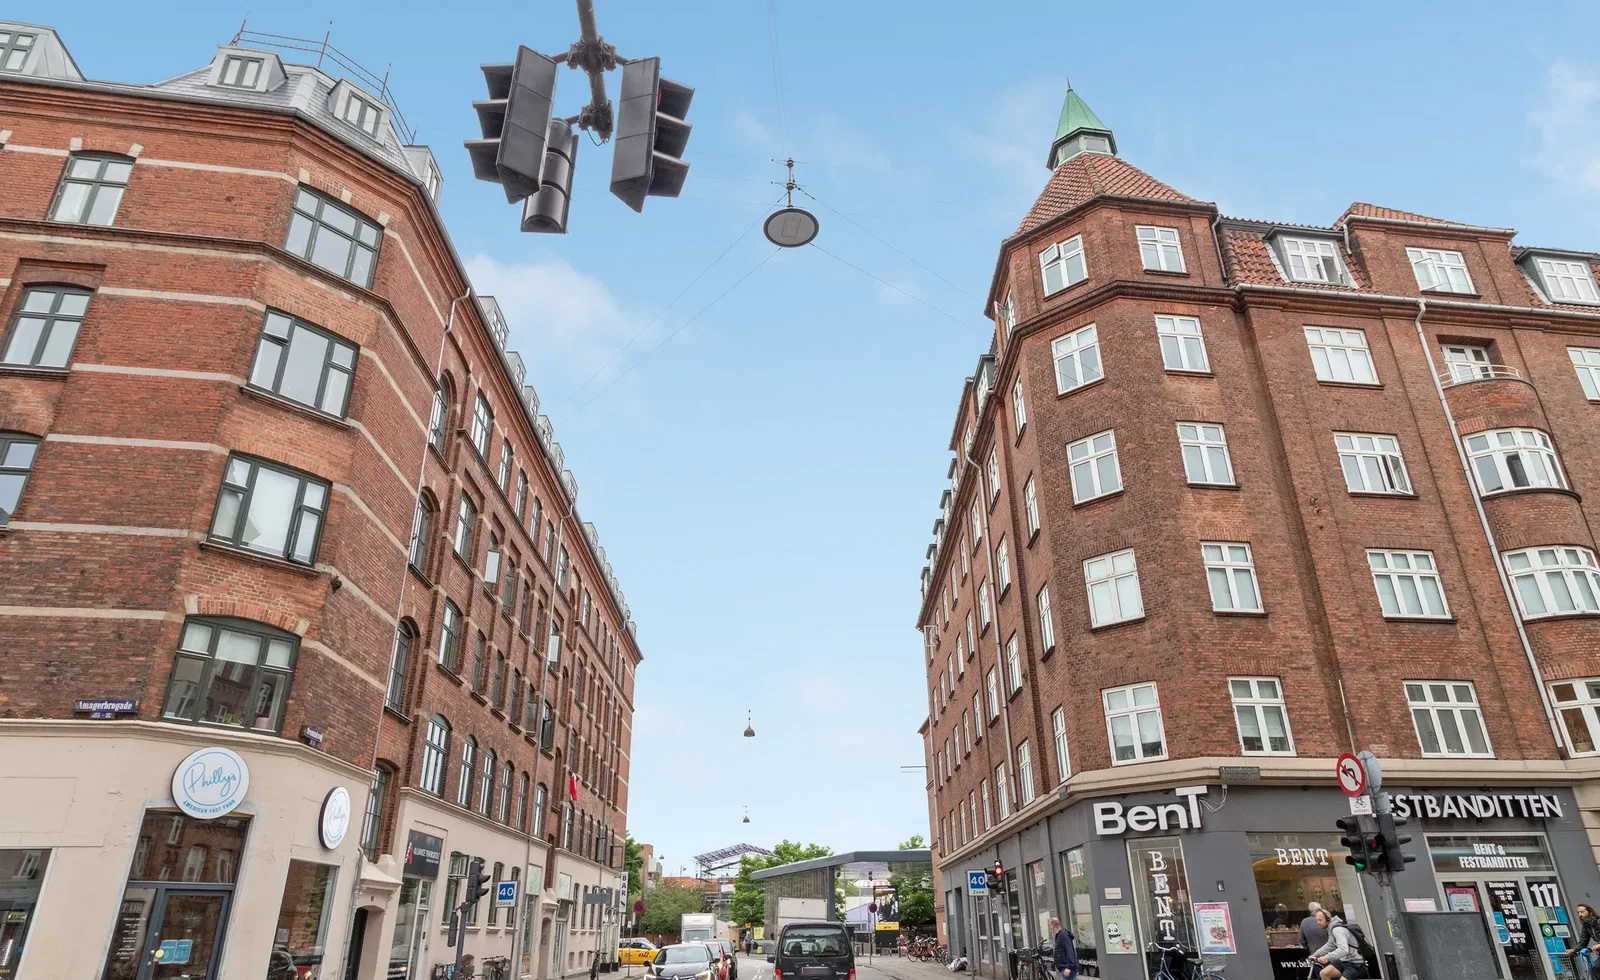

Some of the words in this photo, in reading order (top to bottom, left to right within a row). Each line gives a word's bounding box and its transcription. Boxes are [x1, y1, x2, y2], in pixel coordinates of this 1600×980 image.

[183, 800, 208, 813] AMERICAN
[223, 799, 236, 809] FOOD
[1374, 794, 1563, 818] ESTBANDITTEN
[1274, 848, 1329, 865] BENT
[1473, 844, 1496, 855] BENT
[1498, 846, 1505, 855] &
[1459, 857, 1529, 868] FESTBANDITTEN
[971, 876, 985, 885] 40
[499, 887, 513, 897] 40
[1148, 851, 1175, 941] BENT
[1530, 883, 1560, 907] 117
